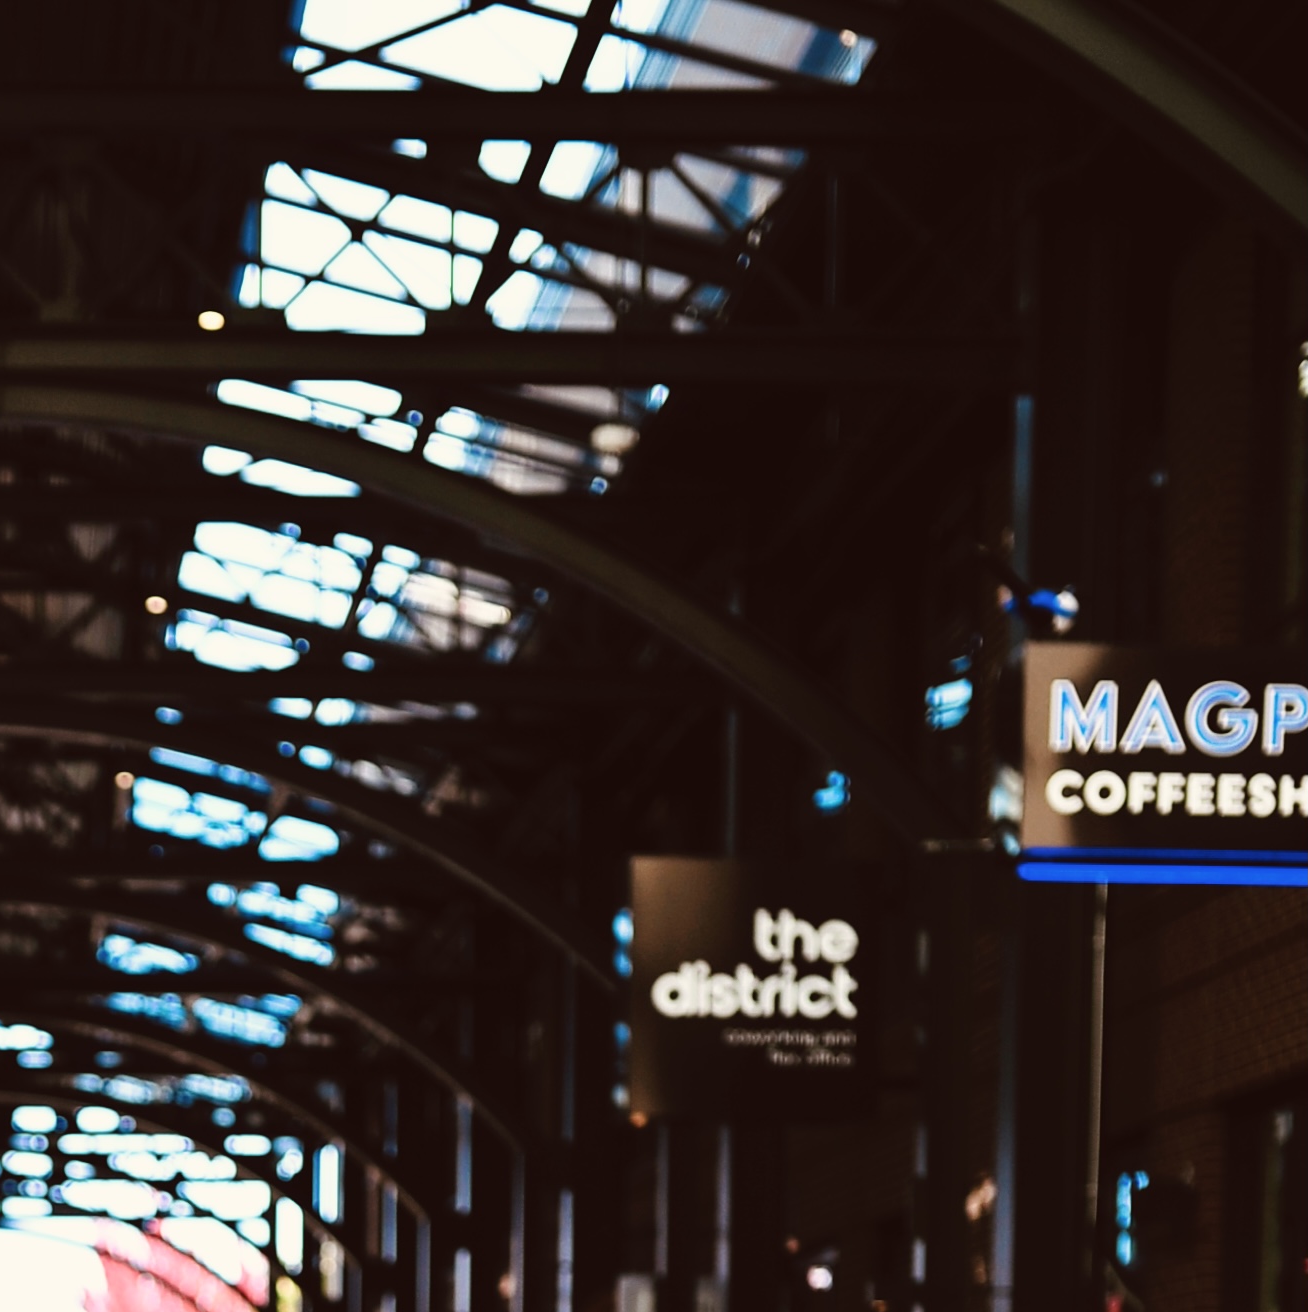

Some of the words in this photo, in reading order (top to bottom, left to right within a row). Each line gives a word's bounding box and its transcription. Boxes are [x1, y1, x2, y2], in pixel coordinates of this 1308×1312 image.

[1049, 678, 1308, 757] MAGP
[754, 907, 859, 963] the
[651, 960, 858, 1019] district
